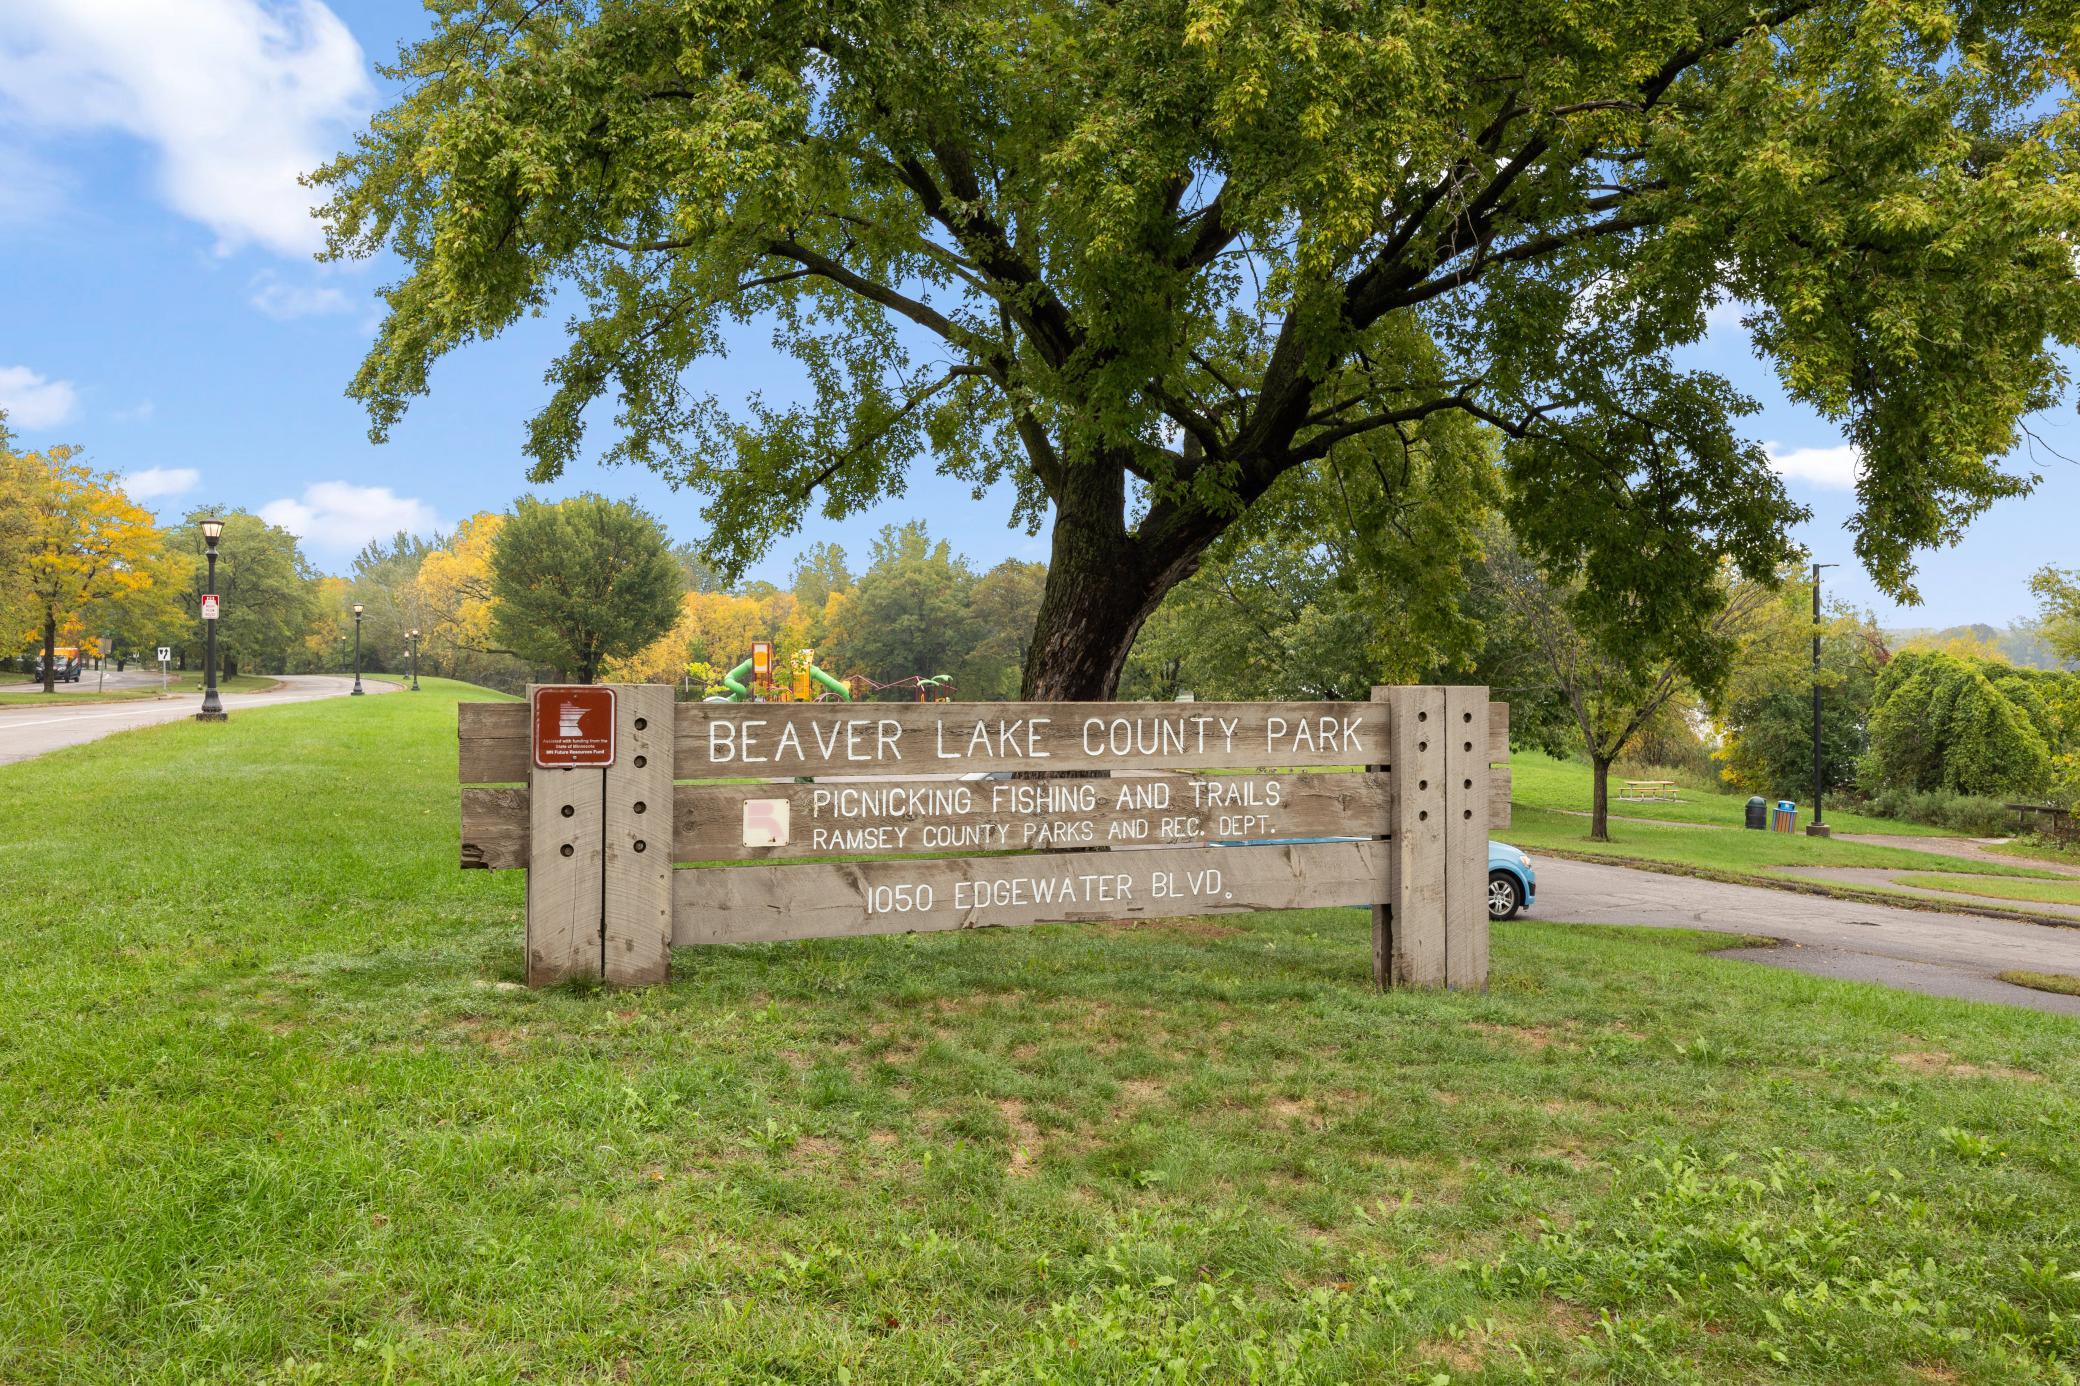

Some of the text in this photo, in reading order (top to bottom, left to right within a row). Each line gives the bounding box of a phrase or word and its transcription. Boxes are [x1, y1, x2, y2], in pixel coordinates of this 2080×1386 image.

[709, 716, 1363, 763] BEAVER LAKE COUNTY PARK
[813, 781, 1281, 818] PICNICKING FISHING AND TRAILS
[812, 814, 1276, 850] RAMSEY COUNTY PARKS AND REC. DEPT.
[867, 868, 1233, 914] 1050 EDGEWATER BLVD.
